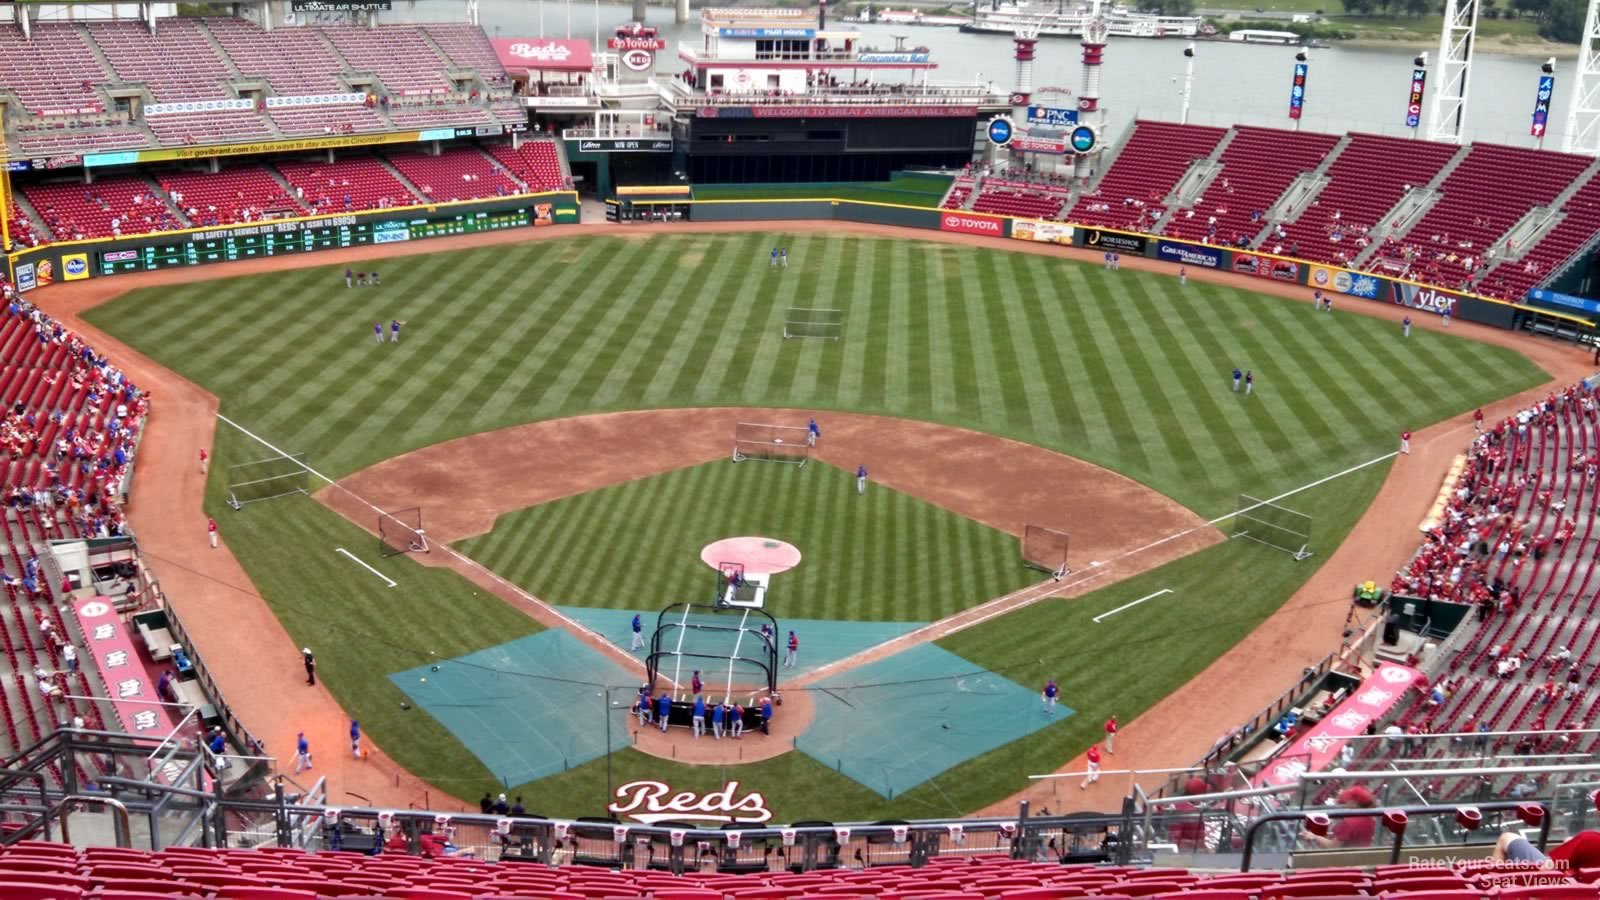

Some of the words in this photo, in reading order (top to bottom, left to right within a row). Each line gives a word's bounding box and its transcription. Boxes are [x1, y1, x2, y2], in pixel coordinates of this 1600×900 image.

[351, 3, 388, 11] SHUTTLE
[626, 39, 658, 48] TOYOTA
[509, 42, 571, 59] Reds
[859, 53, 909, 62] Cincinnati
[910, 53, 929, 62] Bell
[758, 108, 809, 116] WELCOME
[813, 108, 826, 116] TO
[828, 108, 861, 116] GREAT
[865, 108, 918, 116] AMERICAN
[920, 108, 945, 116] BALL
[948, 107, 973, 116] PARK
[1047, 110, 1070, 121] PNC
[194, 146, 249, 157] govibrant.com
[262, 144, 274, 152] fun
[276, 143, 295, 151] ways
[305, 141, 320, 149] stay
[321, 139, 341, 147] active
[614, 141, 625, 149] NOW
[627, 141, 639, 149] OPEN
[1032, 142, 1057, 150] TOYOTA
[192, 233, 204, 241] FOR
[205, 230, 227, 240] SAFETY
[234, 228, 259, 237] SERVICE
[260, 225, 274, 233] TEXT
[306, 219, 324, 228] ISSUE
[960, 218, 998, 231] TOYOTA
[1101, 236, 1139, 247] HORSESHOE
[1391, 281, 1456, 309] Wyler
[607, 780, 774, 824] Reds
